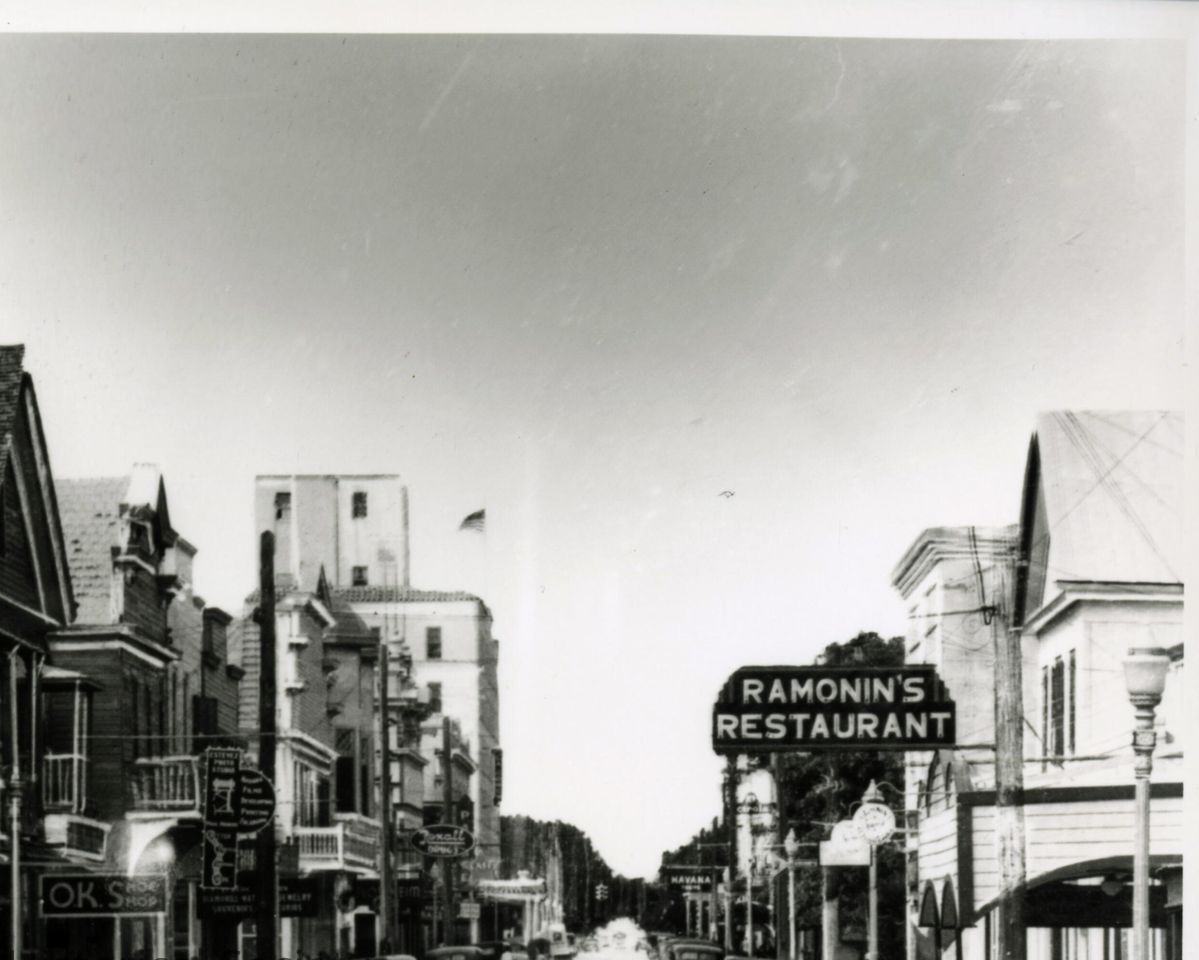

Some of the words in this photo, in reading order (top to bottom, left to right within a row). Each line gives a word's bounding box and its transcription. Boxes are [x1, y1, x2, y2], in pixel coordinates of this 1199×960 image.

[742, 675, 926, 704] RAMONIN'S
[717, 711, 951, 739] RESTAURANT
[671, 875, 712, 884] HAVANA
